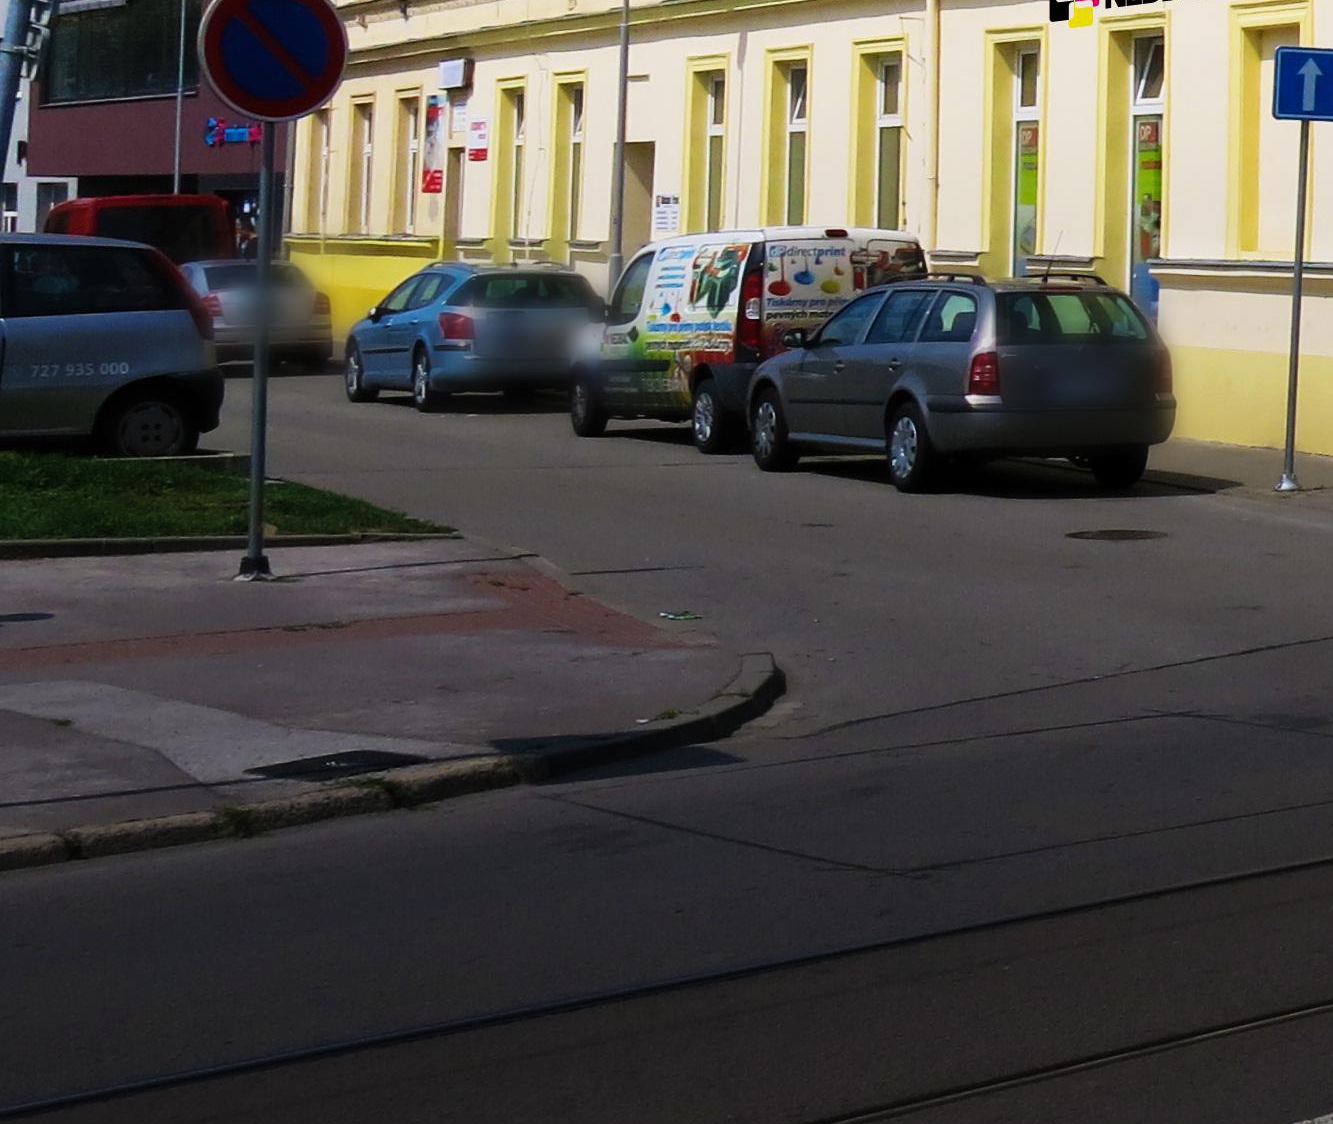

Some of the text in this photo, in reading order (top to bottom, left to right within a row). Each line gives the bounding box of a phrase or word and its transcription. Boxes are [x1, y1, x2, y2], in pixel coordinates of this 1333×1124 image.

[31, 362, 129, 377] 727 935 000
